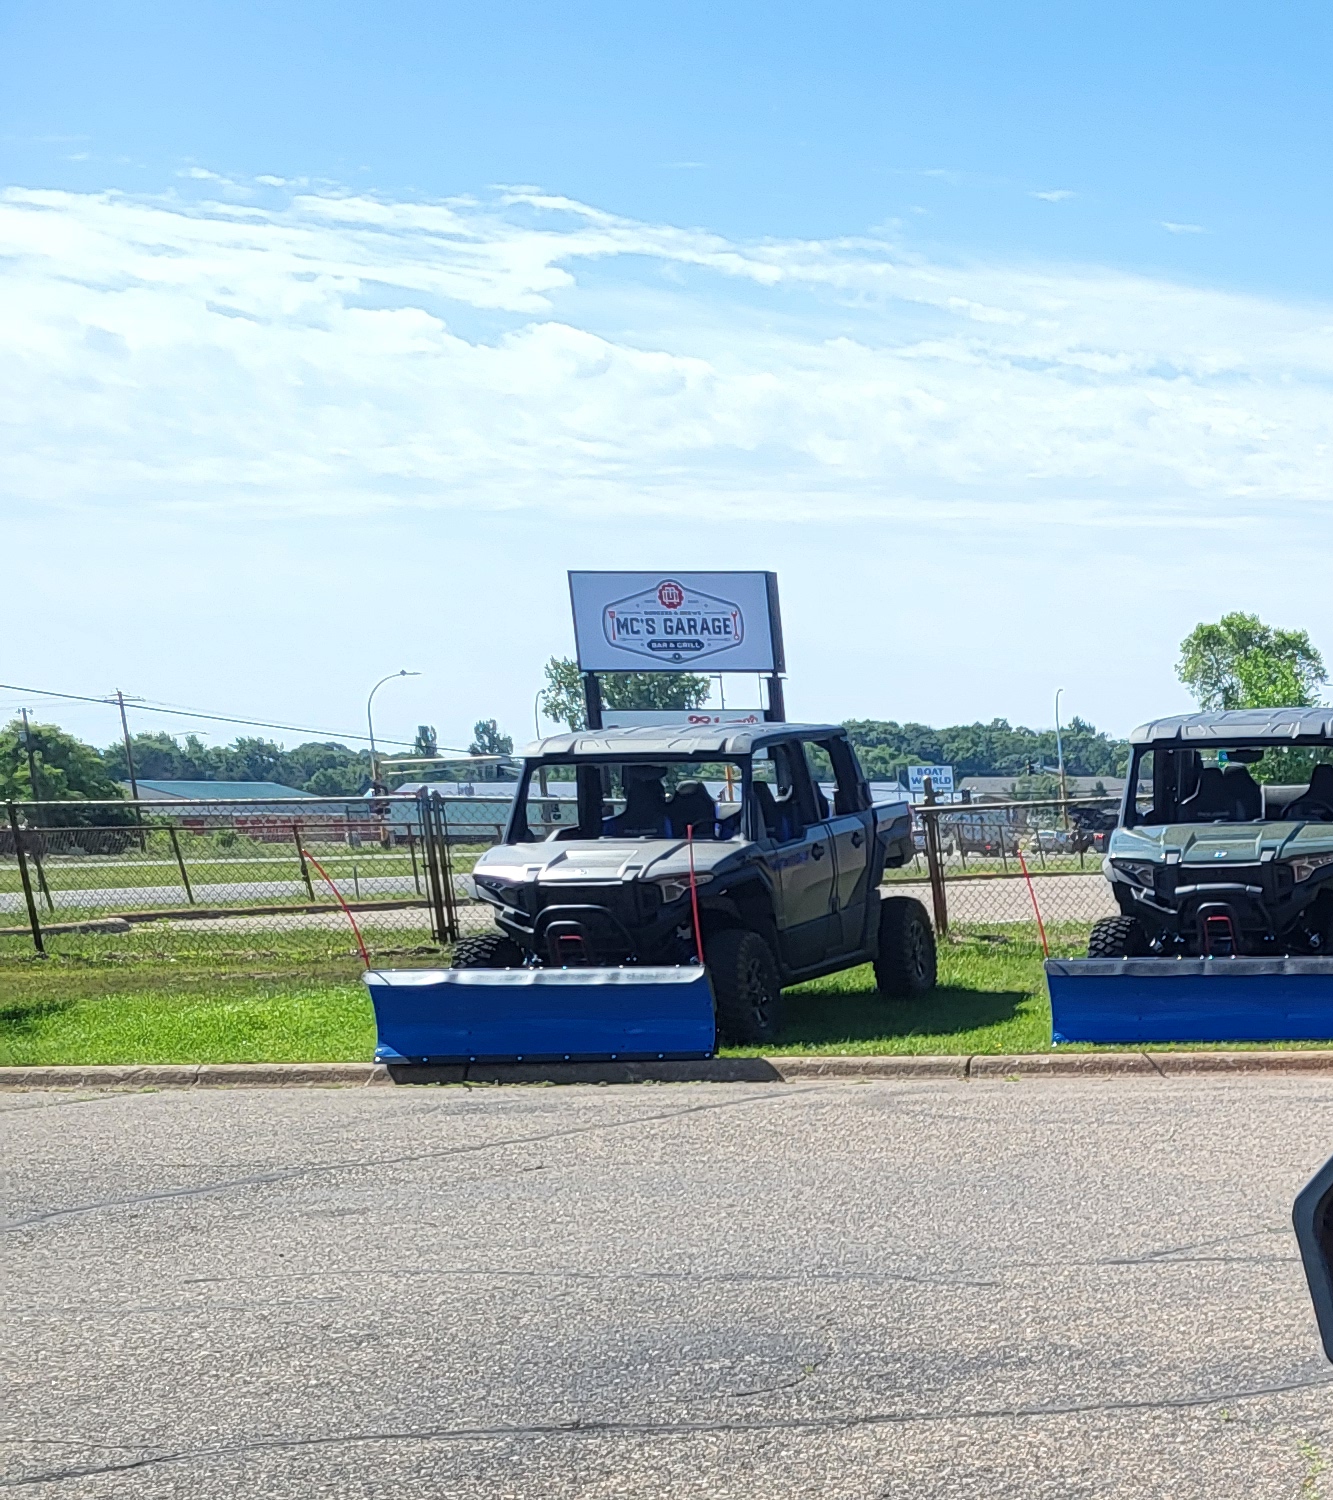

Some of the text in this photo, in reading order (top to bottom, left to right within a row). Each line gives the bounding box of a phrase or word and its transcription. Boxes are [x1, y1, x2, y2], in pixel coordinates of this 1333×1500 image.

[616, 617, 733, 636] MC'S GARAGE
[916, 767, 944, 776] BOAT
[911, 776, 951, 785] WRLD
